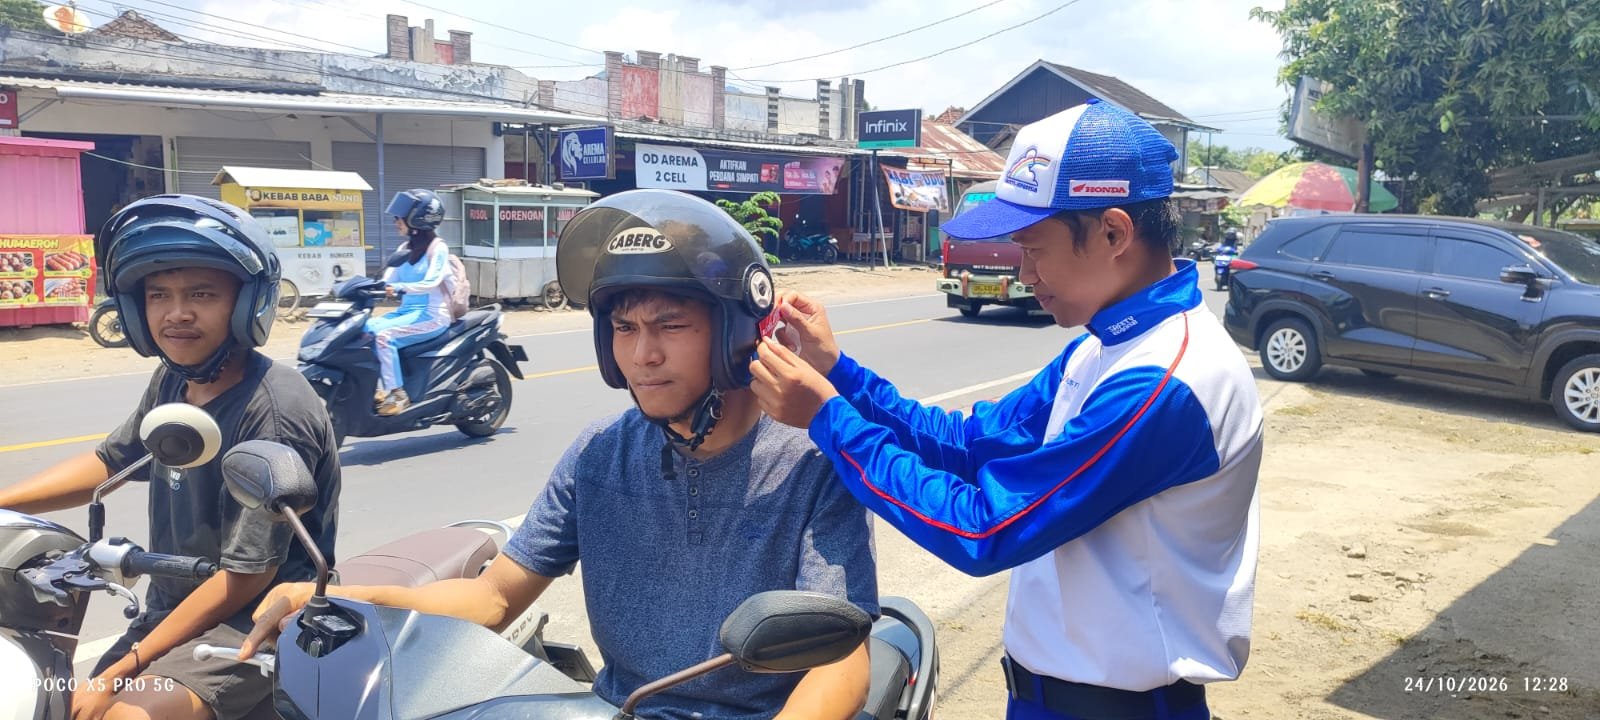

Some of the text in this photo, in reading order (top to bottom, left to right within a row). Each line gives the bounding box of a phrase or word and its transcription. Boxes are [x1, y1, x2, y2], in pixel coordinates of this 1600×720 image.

[865, 119, 908, 134] Infinix
[583, 142, 605, 156] AREMA
[642, 153, 698, 168] OD AREMA
[719, 159, 747, 171] AKTIFKAN
[655, 171, 687, 184] 2 CELL
[709, 170, 736, 182] PERDANA
[736, 172, 759, 184] SIMPATI
[1085, 186, 1127, 194] HONDA
[263, 192, 298, 201] KEBAB
[301, 192, 330, 202] BABA
[609, 233, 666, 251] CABERG
[297, 252, 322, 260] KEBAB
